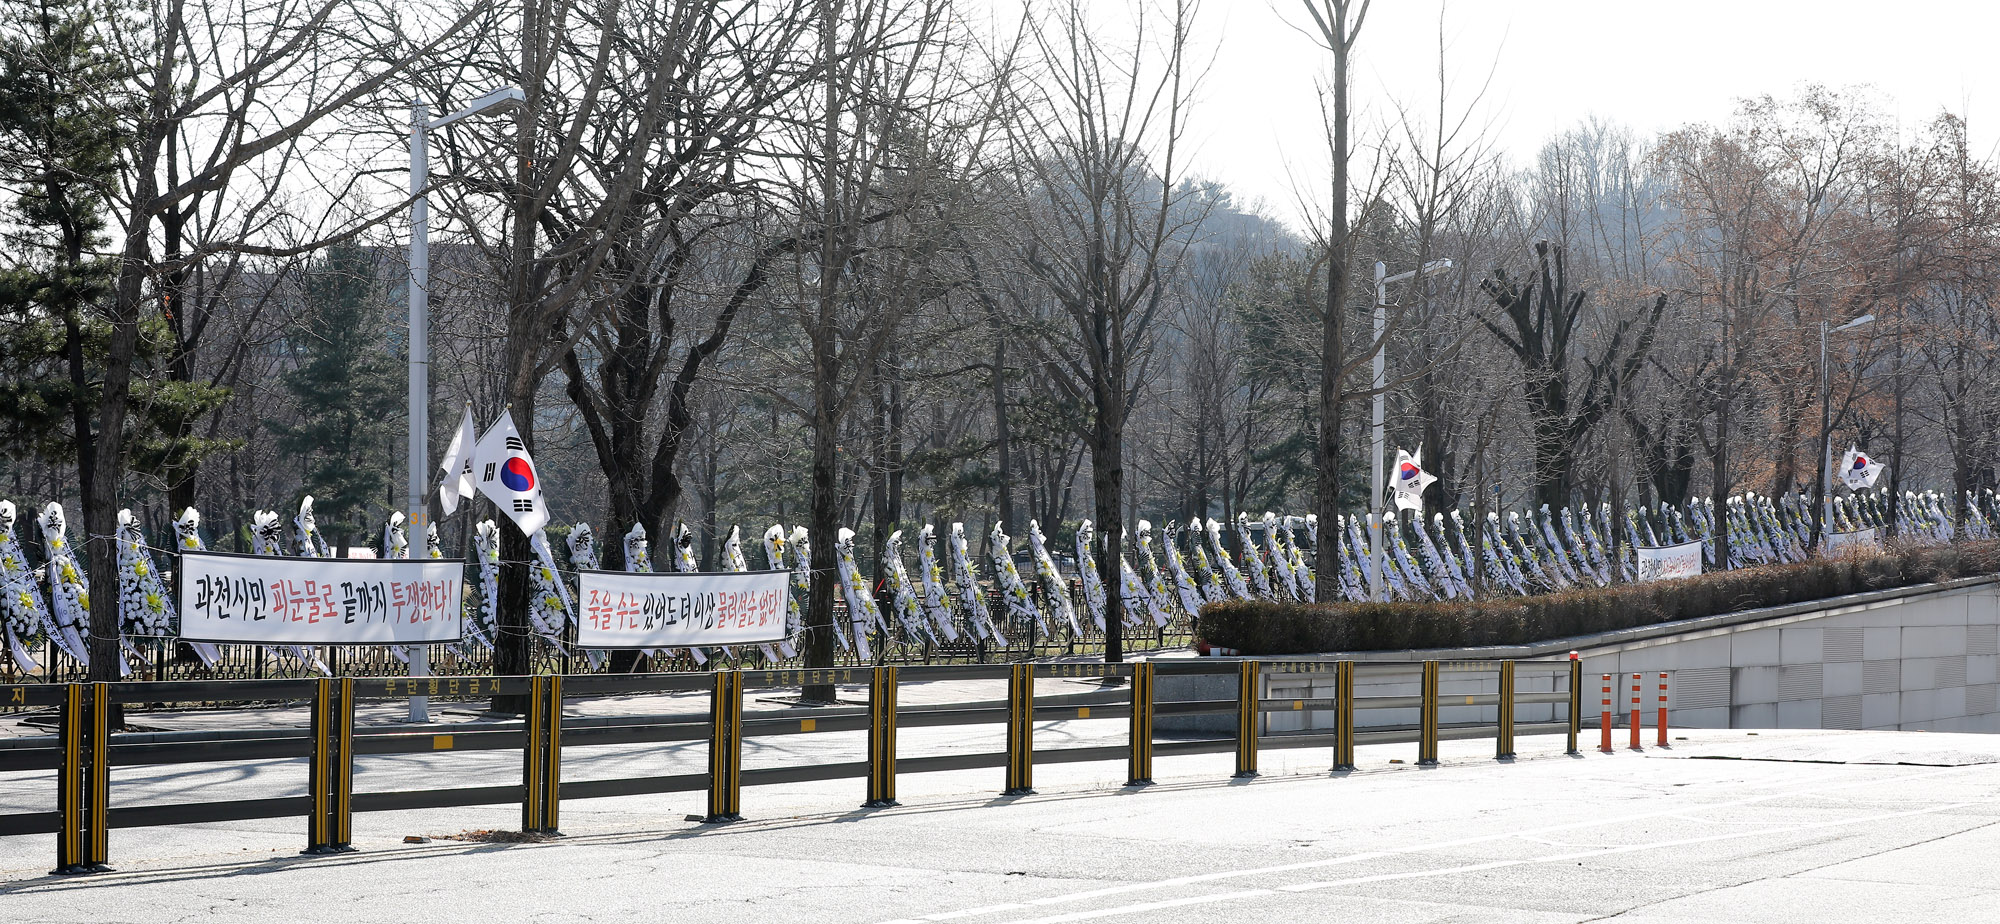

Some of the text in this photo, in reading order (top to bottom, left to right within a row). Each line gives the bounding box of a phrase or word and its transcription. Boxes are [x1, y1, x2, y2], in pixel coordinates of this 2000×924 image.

[194, 574, 267, 622] 과천시민
[270, 580, 338, 625] 피눈물로
[341, 582, 387, 624] 끝까지
[390, 579, 452, 624] 투쟁한다!
[588, 590, 614, 631] 죽을
[617, 593, 640, 630] 수는
[643, 592, 677, 631] 있어도
[681, 592, 691, 628] 더
[694, 592, 716, 630] 이상
[759, 588, 782, 627] 없다!
[11, 686, 25, 704] 지
